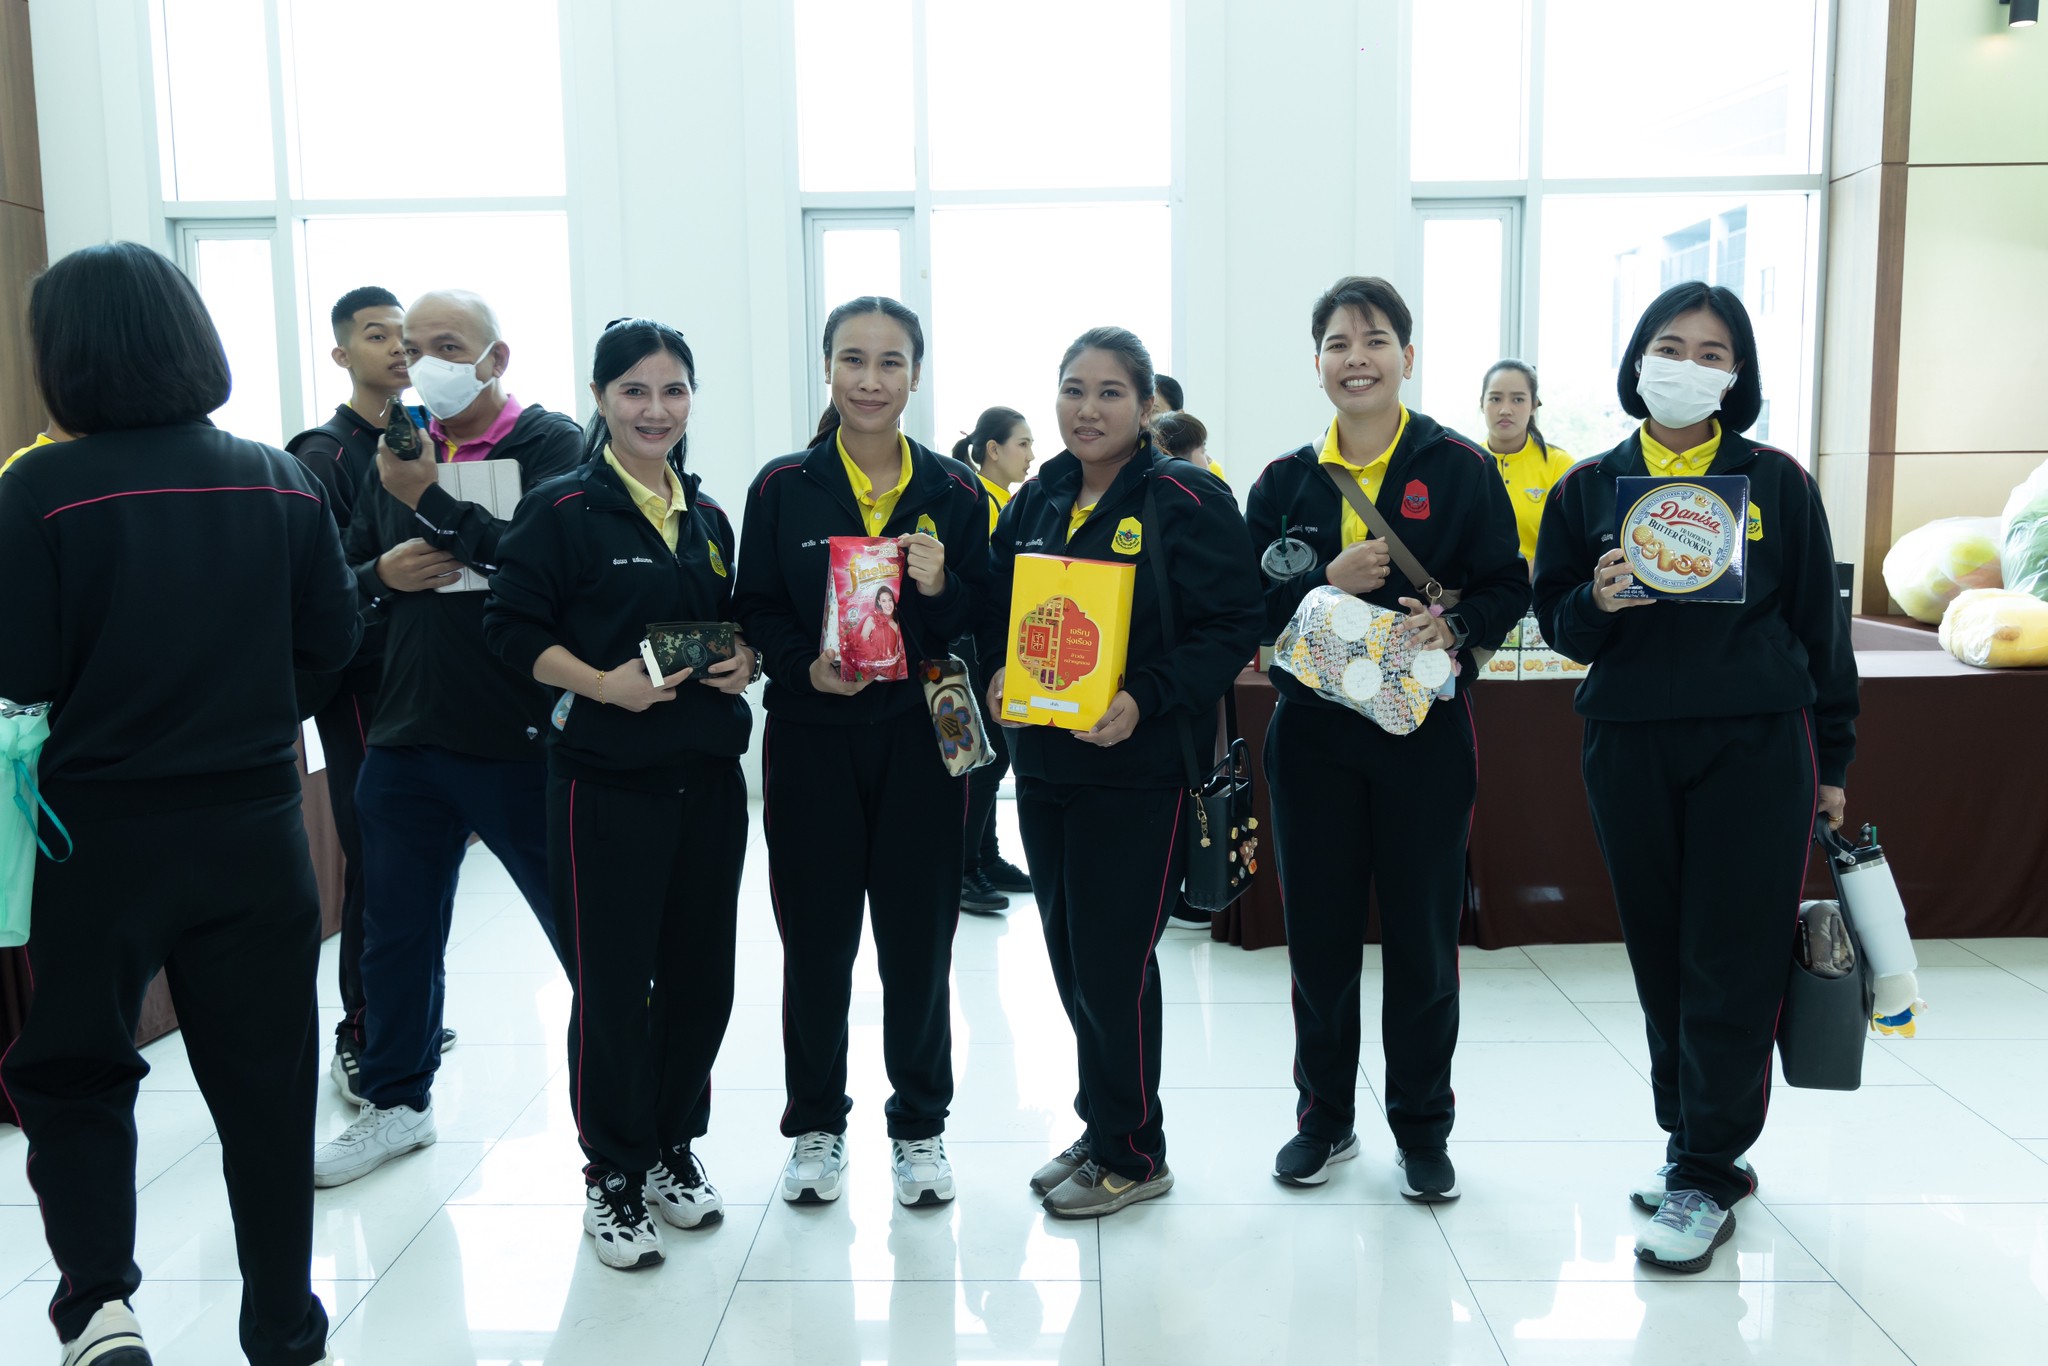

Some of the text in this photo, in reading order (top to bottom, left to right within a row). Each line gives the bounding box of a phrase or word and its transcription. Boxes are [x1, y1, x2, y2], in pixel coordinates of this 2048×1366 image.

[1650, 501, 1721, 531] Danisa
[1648, 518, 1712, 556] BUTTER COOKIES
[1680, 527, 1713, 547] TRADITIONAL
